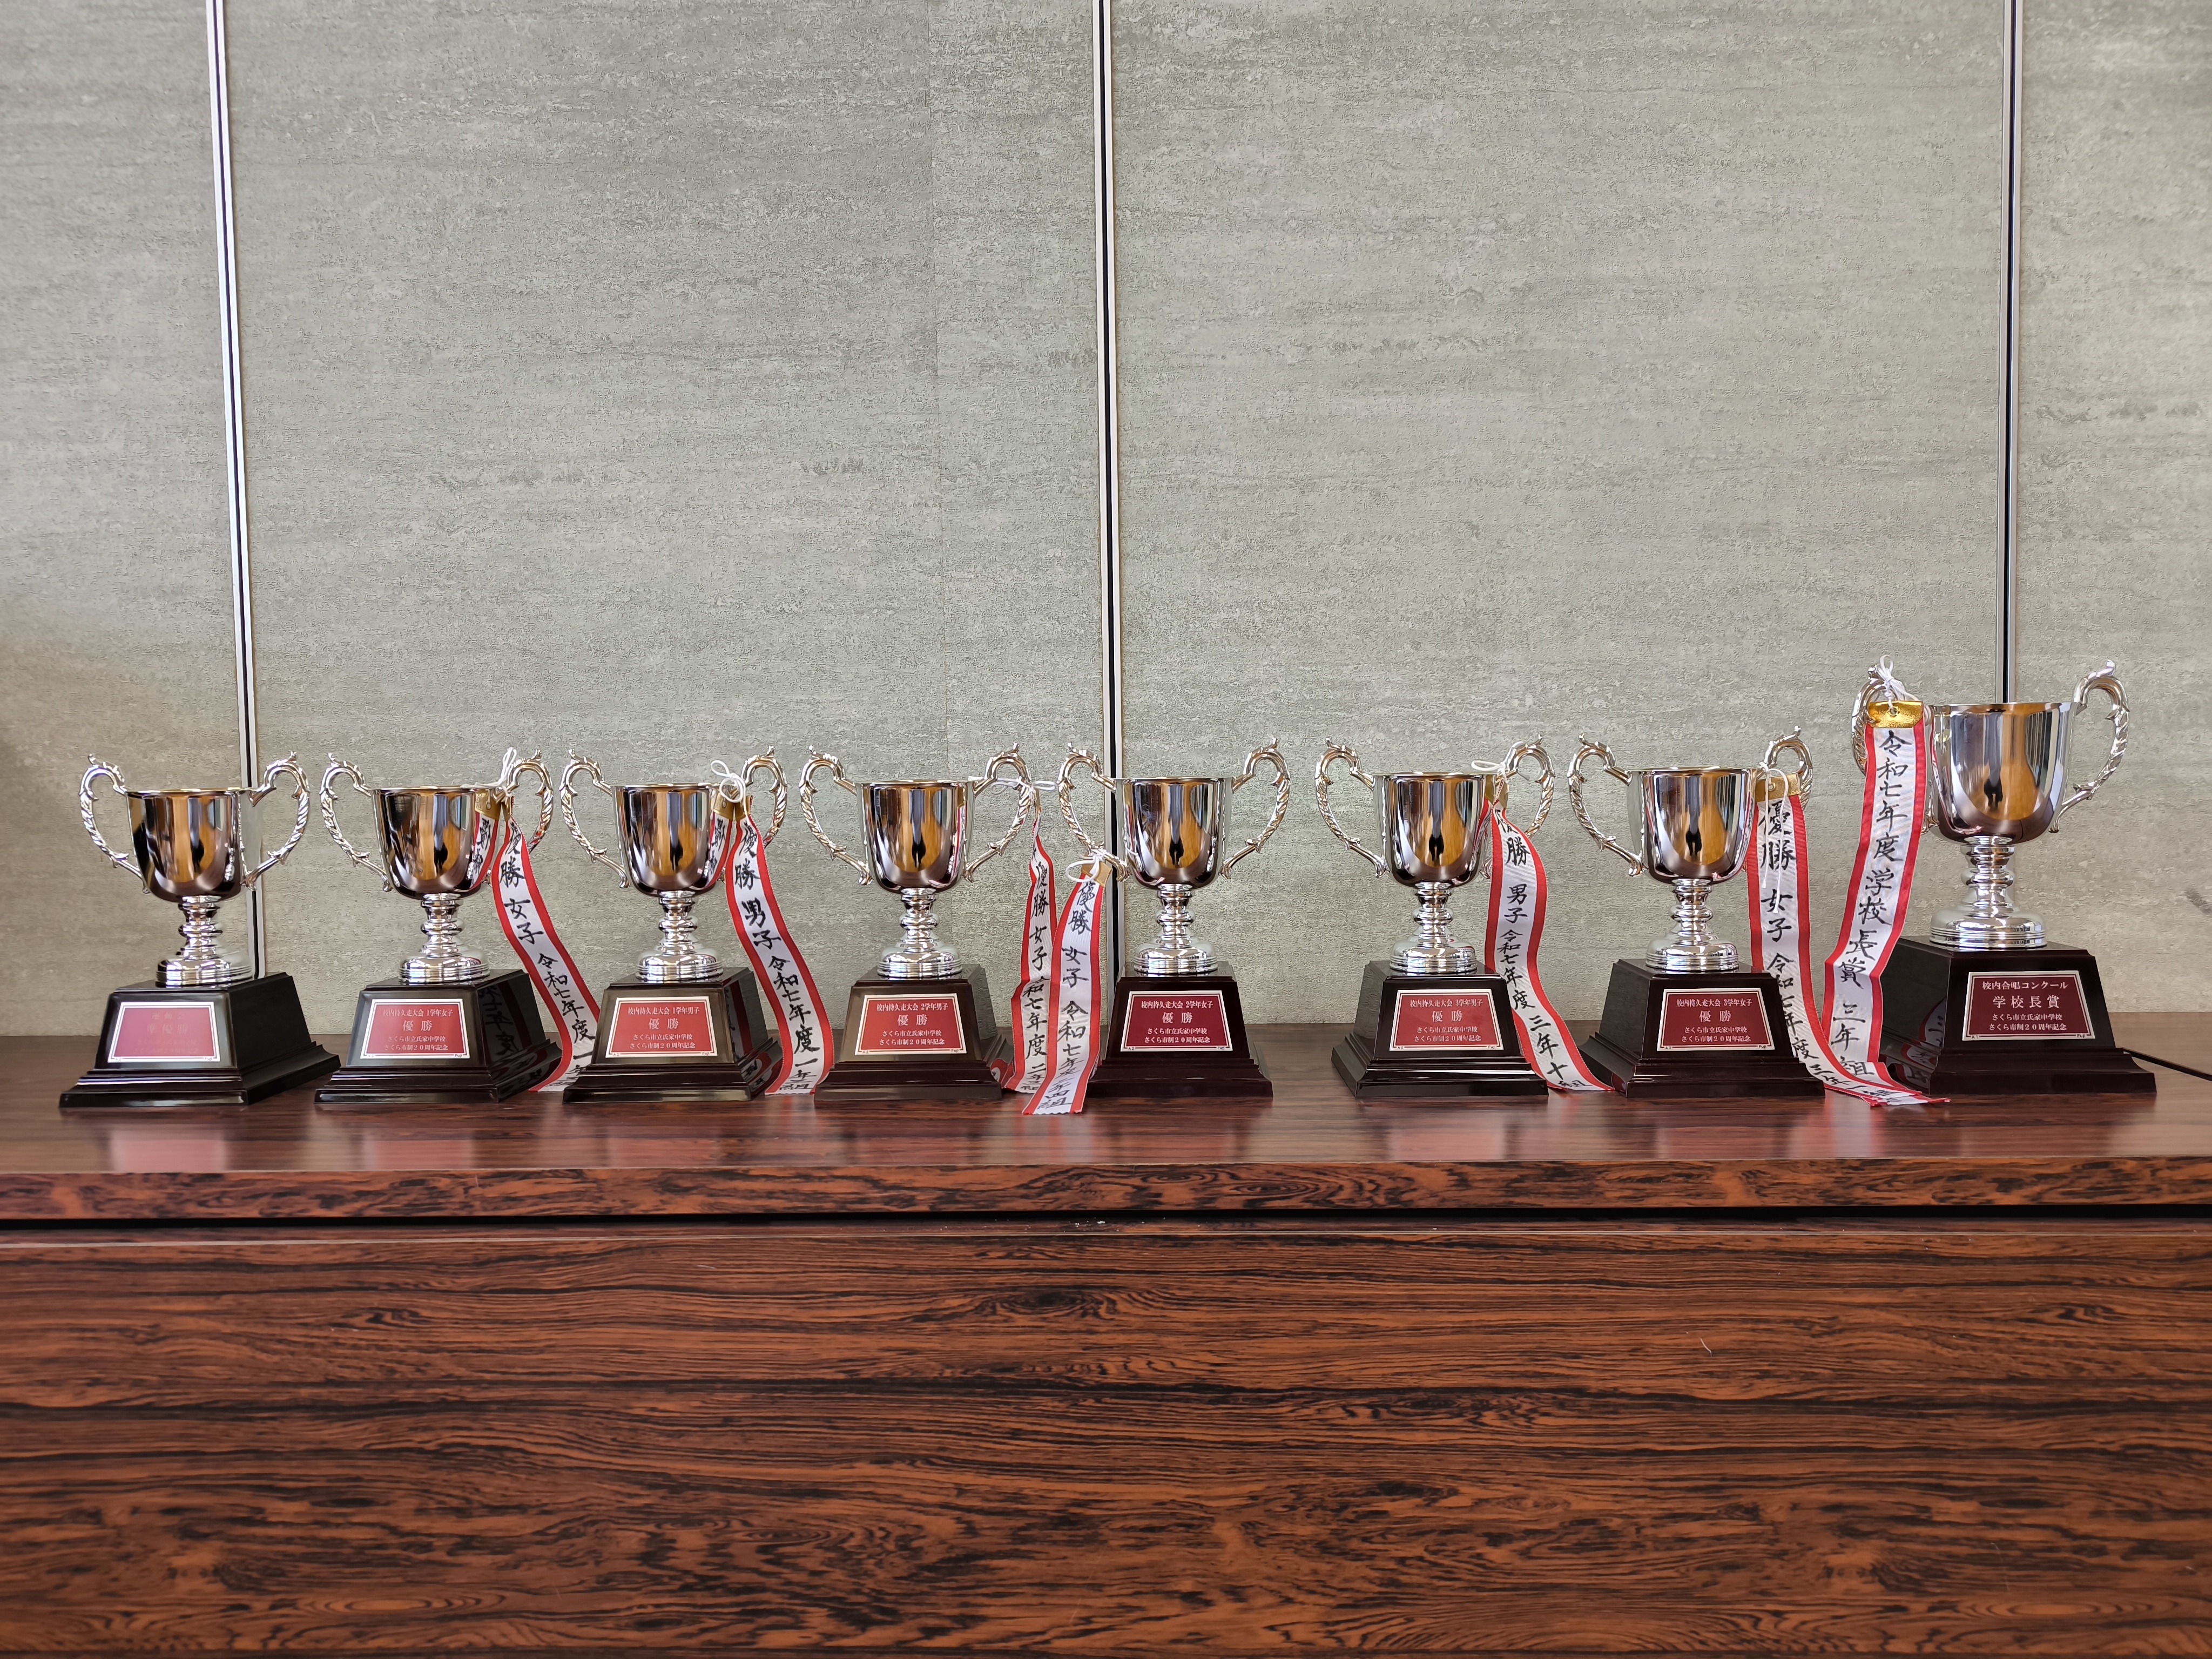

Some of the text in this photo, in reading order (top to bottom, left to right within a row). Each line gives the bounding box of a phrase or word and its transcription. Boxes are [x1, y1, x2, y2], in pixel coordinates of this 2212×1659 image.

[1982, 981, 2069, 990] 校内合唱コンクール
[1992, 995, 2060, 1009] 学校長賞
